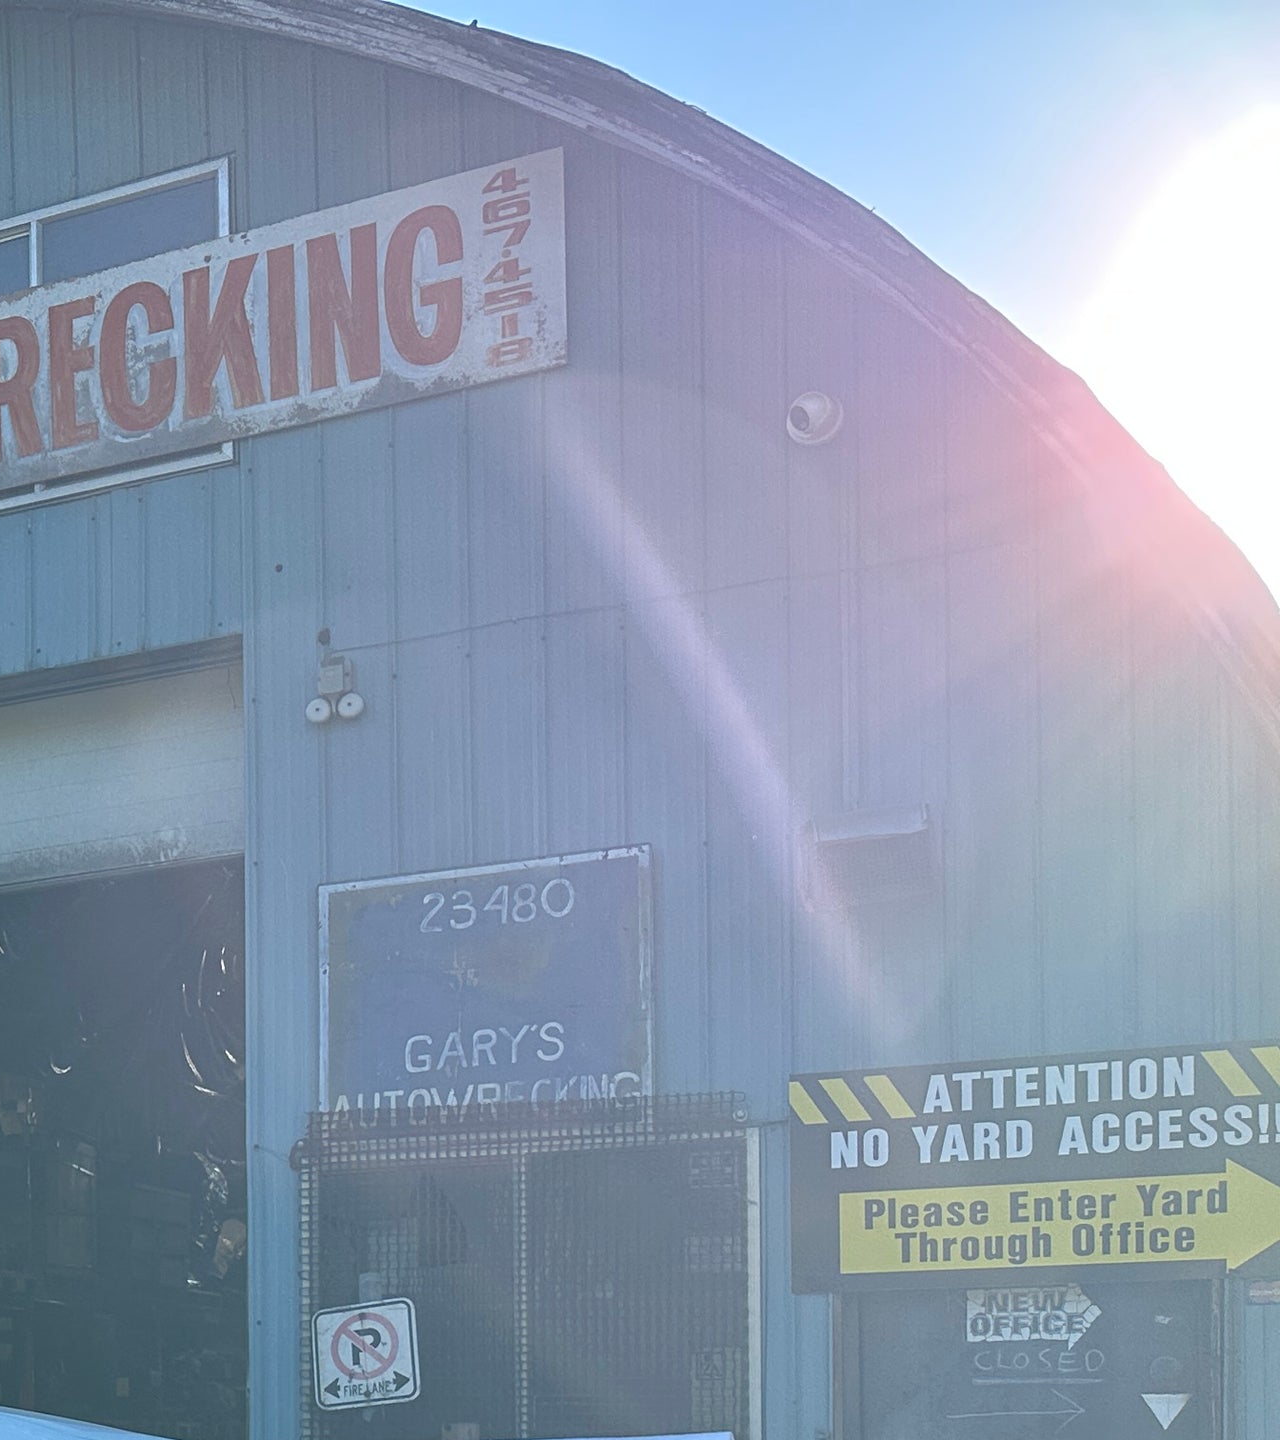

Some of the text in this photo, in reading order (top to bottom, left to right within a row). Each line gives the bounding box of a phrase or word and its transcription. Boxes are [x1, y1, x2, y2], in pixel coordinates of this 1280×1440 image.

[420, 878, 575, 933] 23480
[404, 1021, 566, 1074] GARY'S
[922, 1055, 1195, 1114] ATTENTION
[830, 1127, 889, 1169] NO
[913, 1119, 1034, 1164] YARD
[864, 1180, 1228, 1231] Please Enter Yard
[894, 1221, 1196, 1265] Through Office
[985, 1288, 1066, 1313] NEW
[969, 1312, 1086, 1337] OFFICE
[974, 1348, 1105, 1372] CLOSED
[343, 1380, 394, 1398] FIRE LANE
